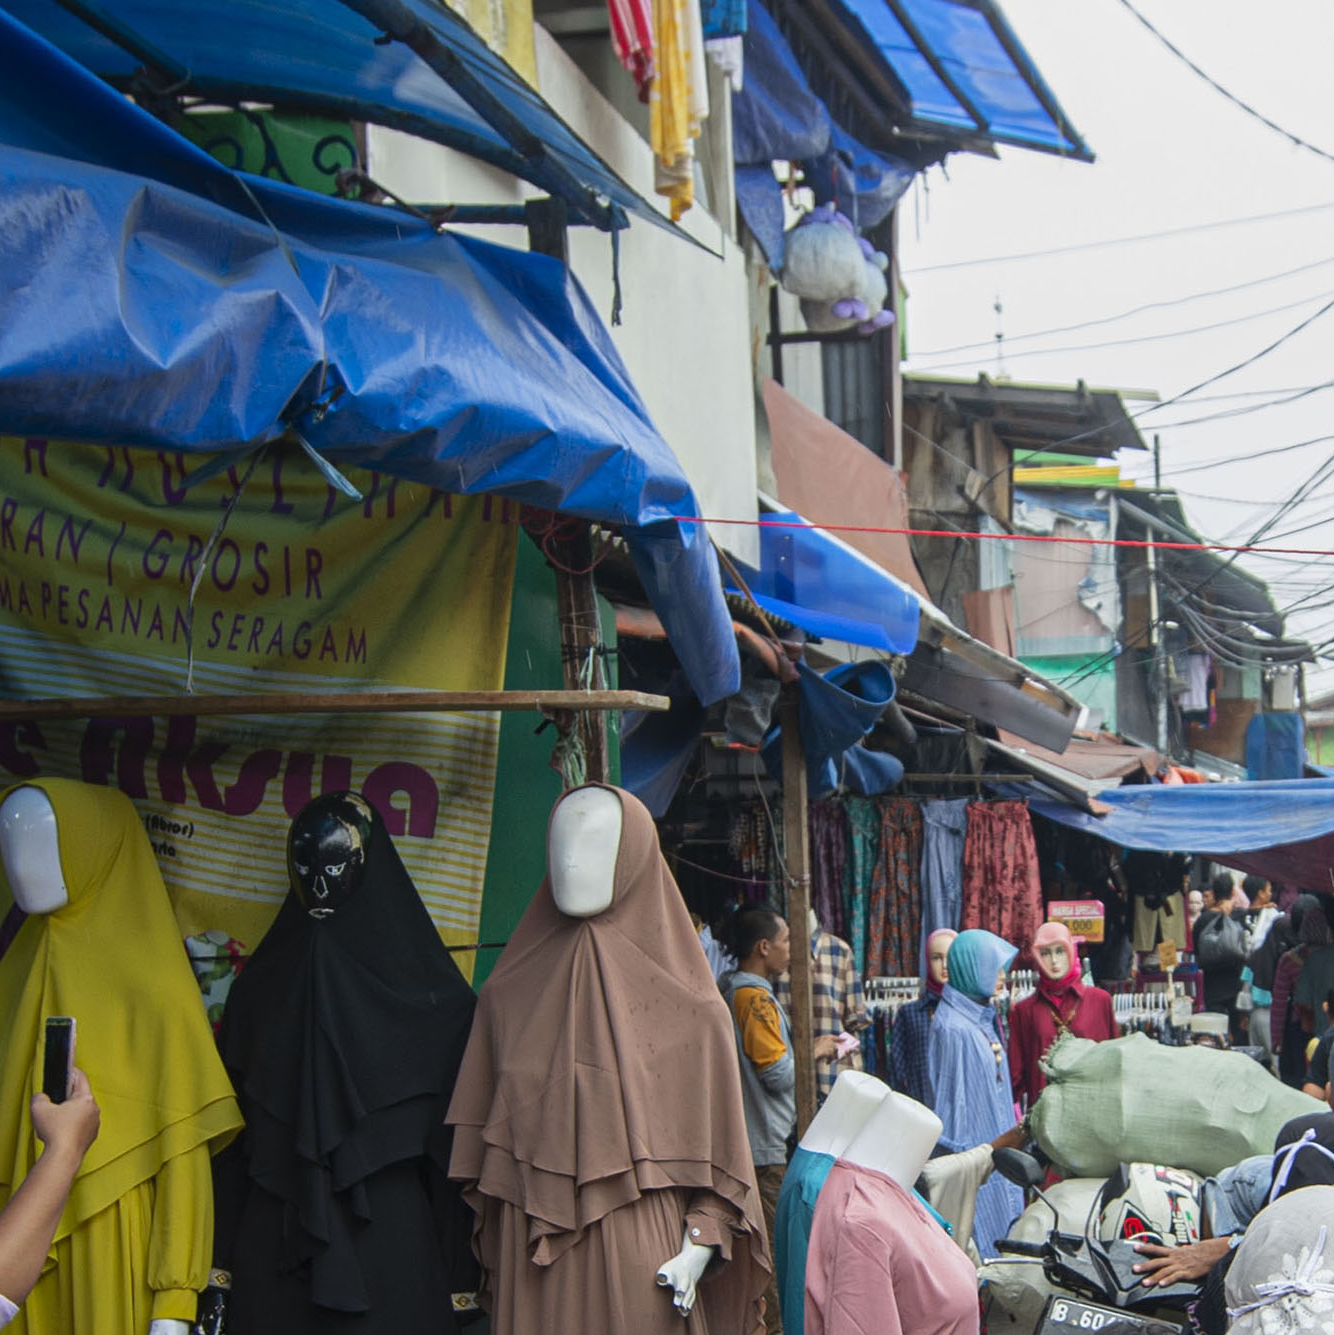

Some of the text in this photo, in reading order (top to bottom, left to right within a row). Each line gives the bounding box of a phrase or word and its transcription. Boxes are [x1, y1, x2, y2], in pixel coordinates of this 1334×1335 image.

[142, 528, 323, 599] GROSIR
[41, 580, 194, 644] PESANAN
[207, 610, 367, 664] SERAGAM
[1050, 1303, 1069, 1323] B
